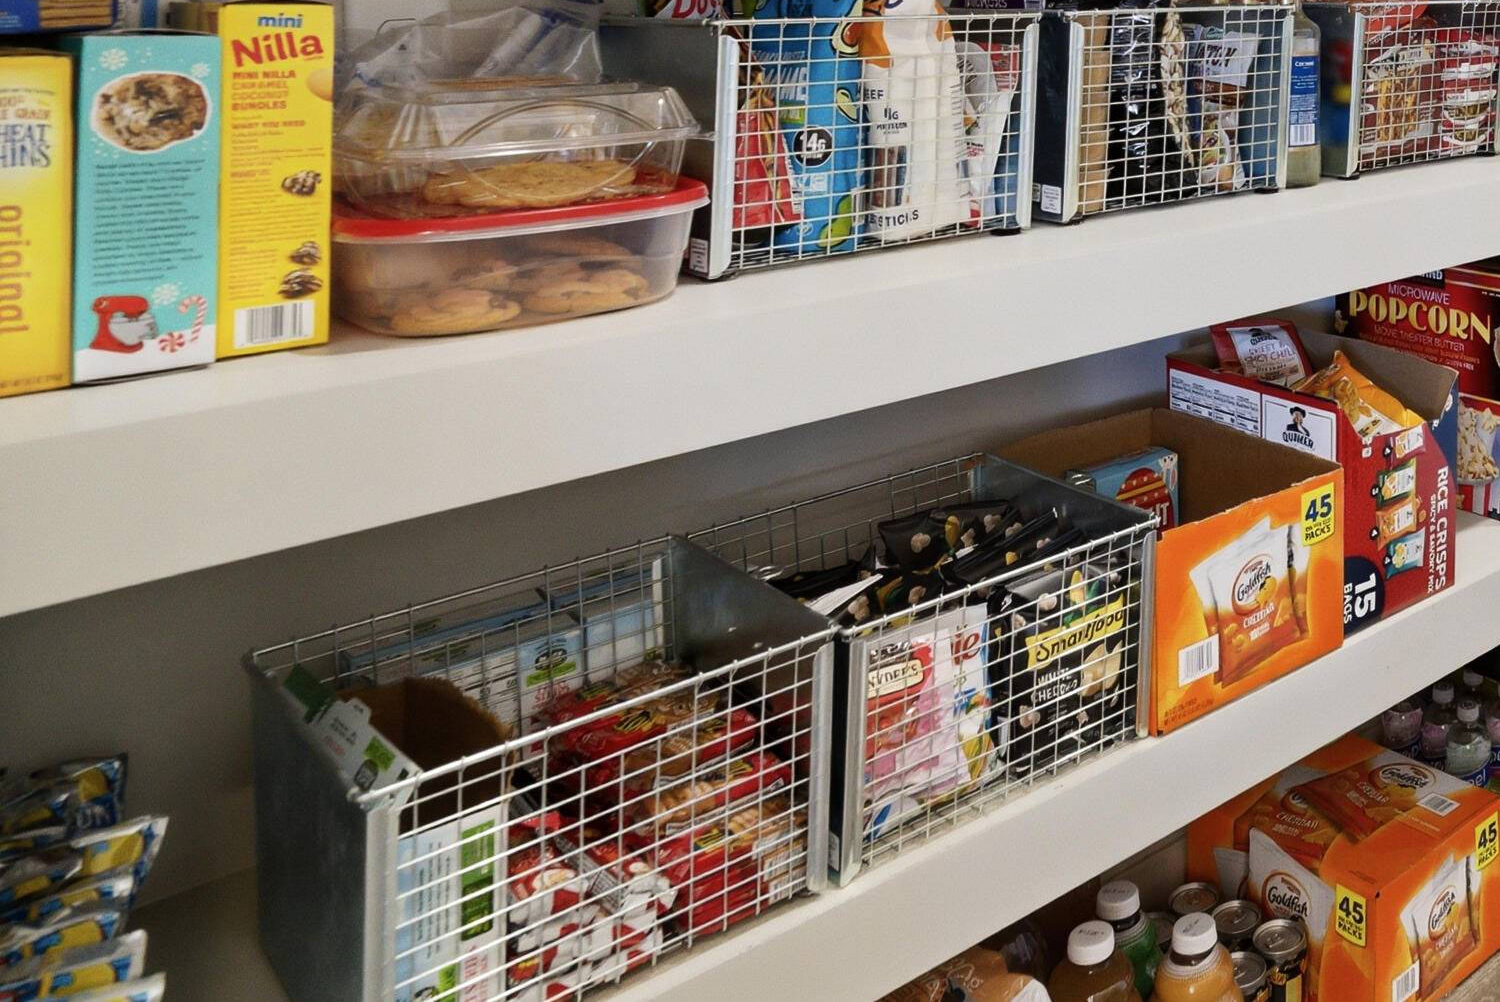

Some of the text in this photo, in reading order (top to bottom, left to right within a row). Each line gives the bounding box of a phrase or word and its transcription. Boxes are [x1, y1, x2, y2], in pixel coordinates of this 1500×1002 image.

[257, 12, 303, 29] mini
[231, 31, 324, 67] Nilla
[231, 100, 287, 111] BUNDLES
[1388, 282, 1451, 306] MICROWAVE
[1349, 290, 1491, 345] POPCORN
[1433, 336, 1466, 353] BUTTER
[1282, 430, 1315, 450] QUAKER
[1305, 493, 1333, 523] 45
[1304, 525, 1332, 542] PACKS
[1435, 465, 1449, 591] RICE CRISPS
[1237, 560, 1273, 603] Goldfish
[1354, 571, 1377, 619] 15
[1343, 582, 1353, 625] BAGS
[1034, 608, 1124, 662] Smartfood
[1476, 817, 1499, 850] 45
[1266, 885, 1309, 919] Goldfish
[1338, 894, 1364, 926] 45
[1337, 920, 1363, 941] PACKS
